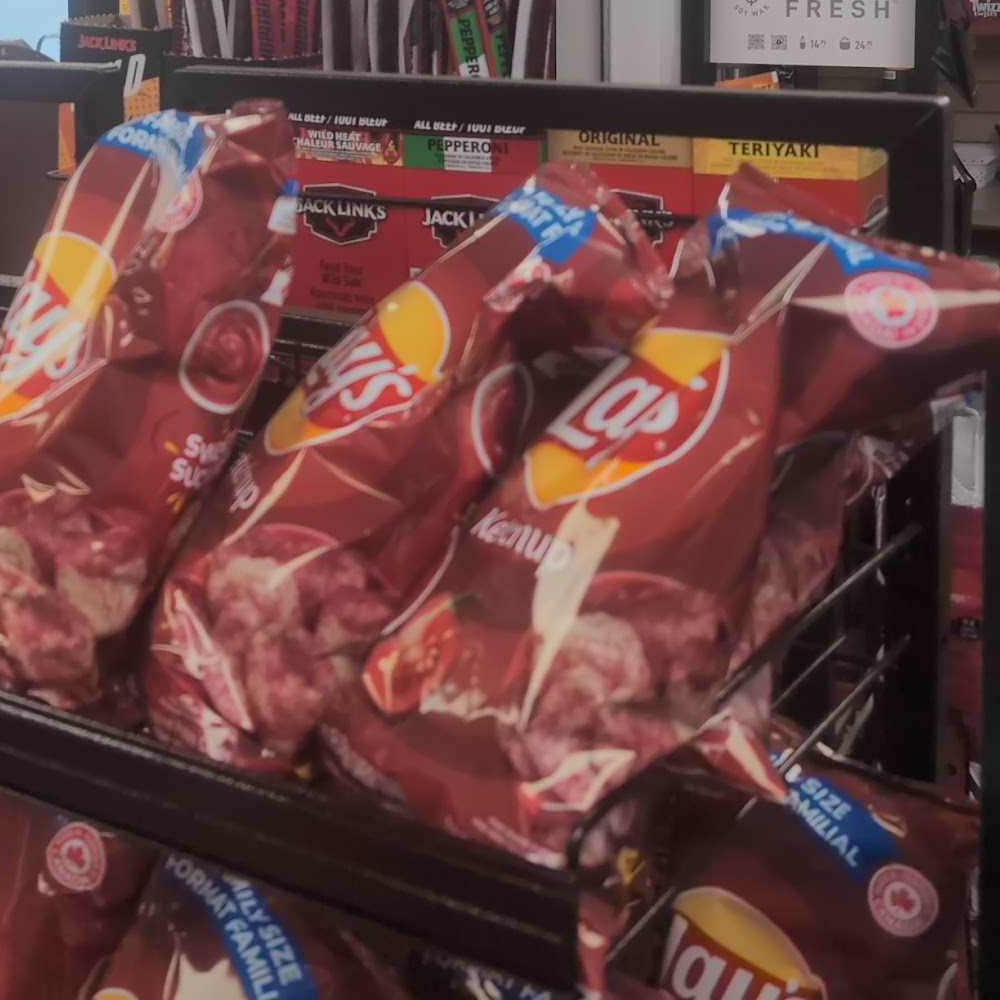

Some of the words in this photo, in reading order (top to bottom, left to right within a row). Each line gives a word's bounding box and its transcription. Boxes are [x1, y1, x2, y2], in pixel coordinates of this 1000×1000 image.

[733, 4, 749, 17] SOY
[751, 4, 771, 17] WAX
[785, 0, 890, 19] FRESH
[970, 0, 1000, 13] Twizz
[456, 17, 480, 77] PEPPER
[307, 129, 334, 140] WILD
[334, 131, 361, 141] HEAT
[578, 130, 660, 147] ORIGINAL
[335, 141, 381, 152] SAUVAGE
[427, 138, 509, 155] PEPPERONI
[728, 142, 820, 158] TERIYAKI
[421, 207, 468, 229] JACK
[801, 777, 852, 821] SIZE
[788, 789, 860, 868] AMILIAL
[224, 918, 280, 1000] FAMILI
[257, 923, 303, 986] SIZE
